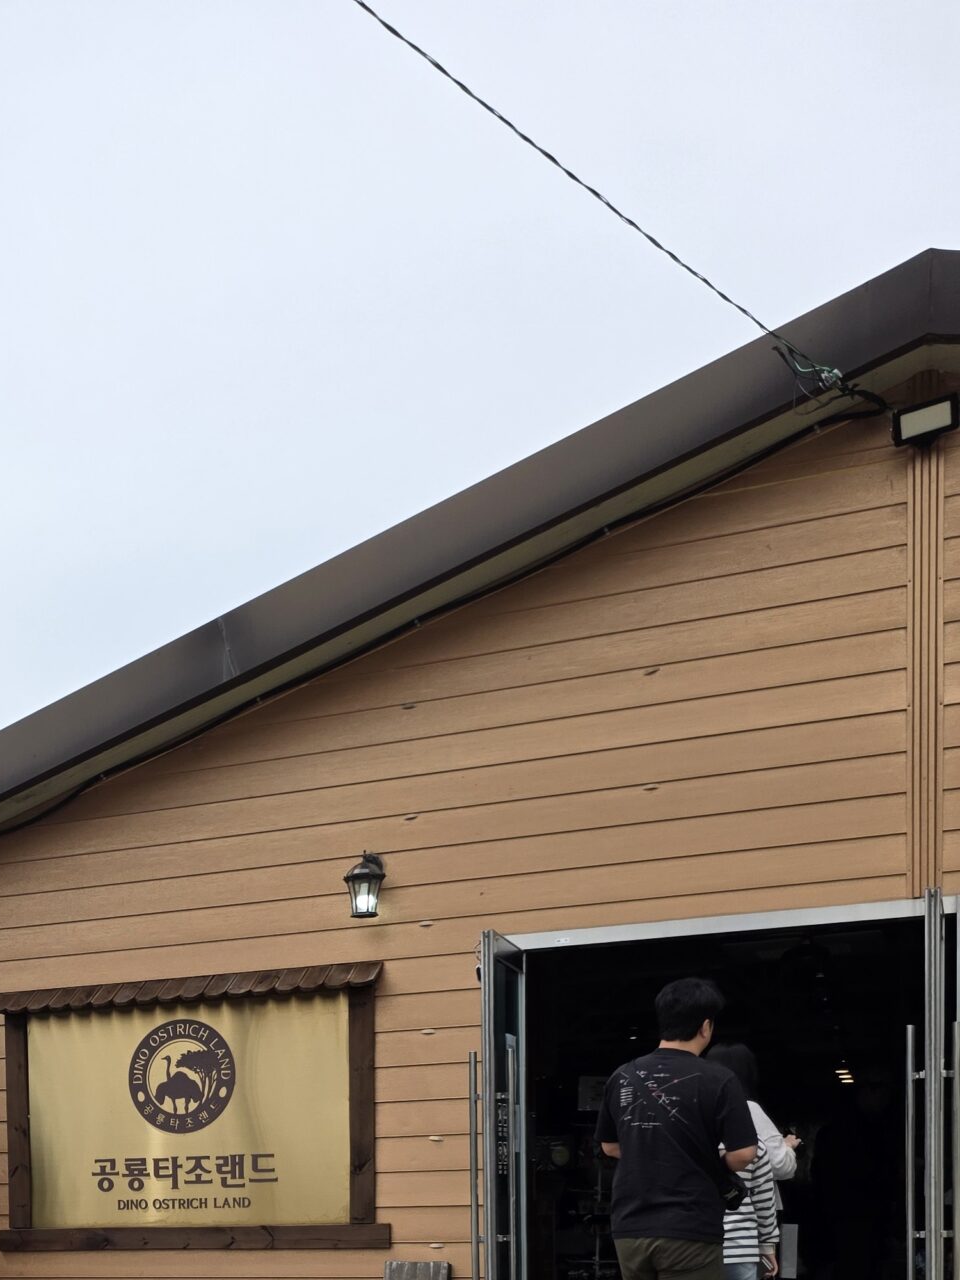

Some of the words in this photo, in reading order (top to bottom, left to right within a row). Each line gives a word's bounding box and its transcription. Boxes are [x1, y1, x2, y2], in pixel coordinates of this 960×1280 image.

[133, 1048, 149, 1084] DINO
[149, 1023, 209, 1048] OSTRICH
[209, 1038, 232, 1080] LAND
[91, 1153, 279, 1193] 공룡타조랜드
[117, 1199, 149, 1211] DINO
[152, 1197, 209, 1210] OSTRICH
[213, 1197, 252, 1209] LAND
